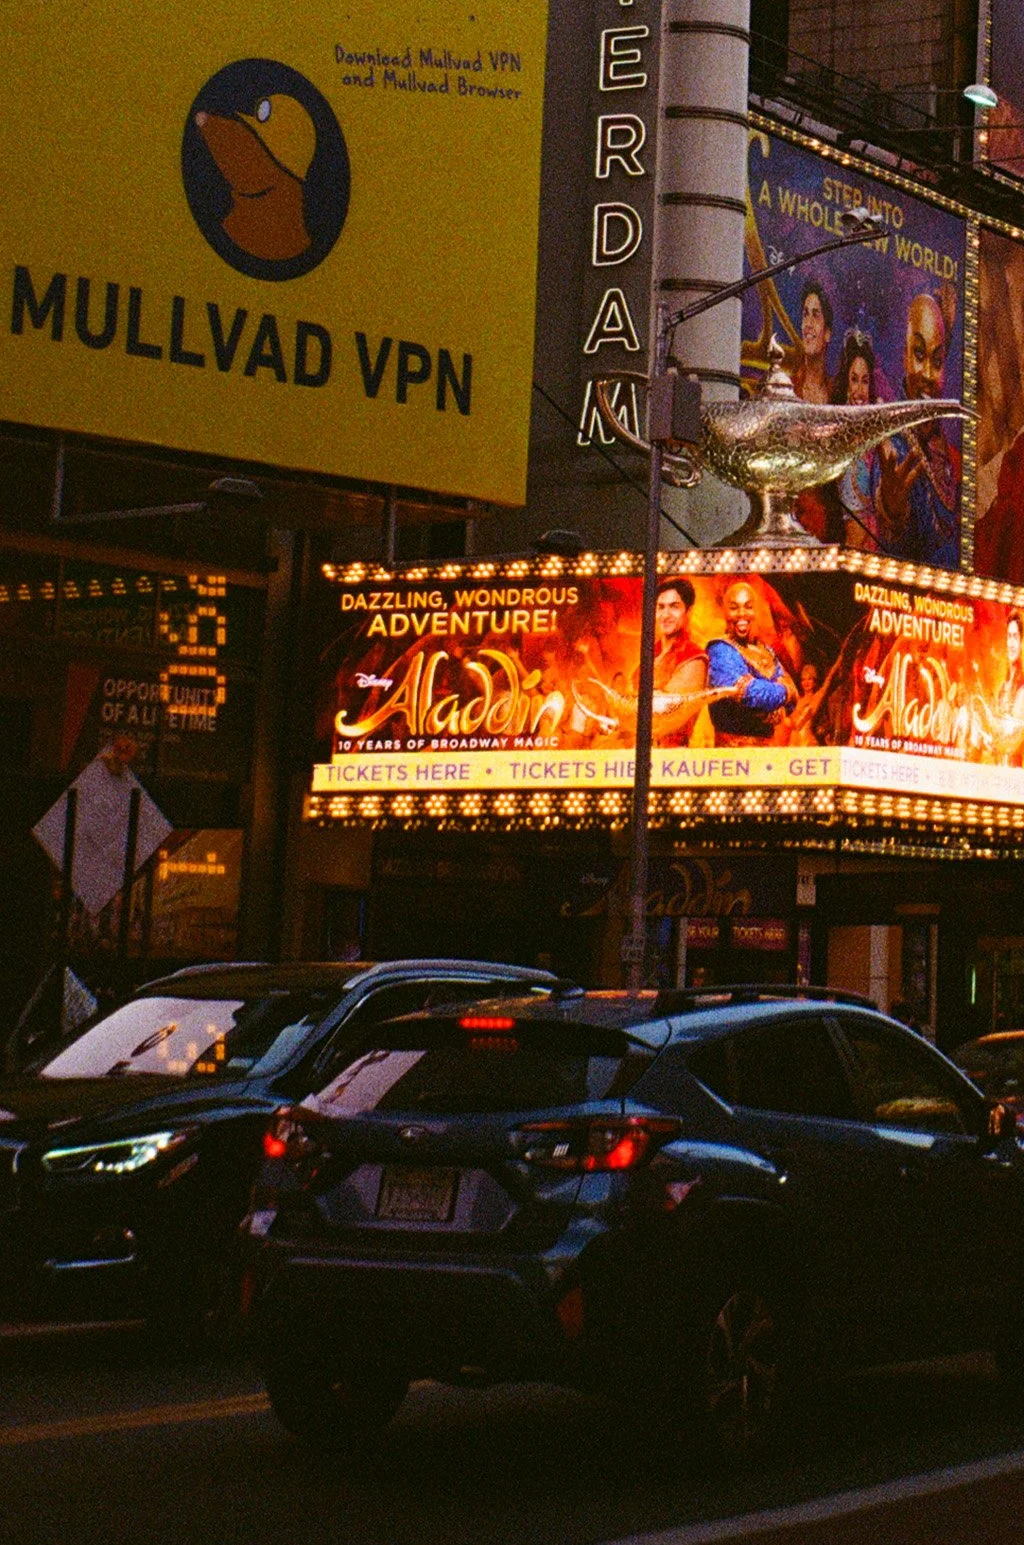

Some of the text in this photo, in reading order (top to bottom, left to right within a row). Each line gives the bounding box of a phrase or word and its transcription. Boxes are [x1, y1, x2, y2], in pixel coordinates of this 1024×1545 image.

[334, 44, 522, 73] Download Mullvad VPN
[342, 67, 522, 100] and Mullvad Browser
[823, 177, 863, 213] STEP
[758, 179, 772, 207] A
[778, 185, 844, 238] WHOLE
[895, 233, 959, 282] WORLD!
[10, 264, 473, 417] MULLVAD VPN
[342, 587, 579, 611] DAZZLING, WONDROUS
[854, 582, 975, 624] DAZZLING, WONDROUS
[367, 609, 558, 638] ADVENTURE!
[869, 608, 965, 648] ADVENTURE!
[335, 650, 565, 737] Aladdin
[852, 651, 969, 745] Aladdin
[338, 735, 559, 751] 10 YEARS OF BROADWAY MAGIC
[327, 764, 408, 783] TICKETS
[415, 762, 471, 782] HERE
[510, 760, 597, 780] TICKETS
[661, 758, 750, 778] KAUFEN
[788, 757, 832, 776] GET
